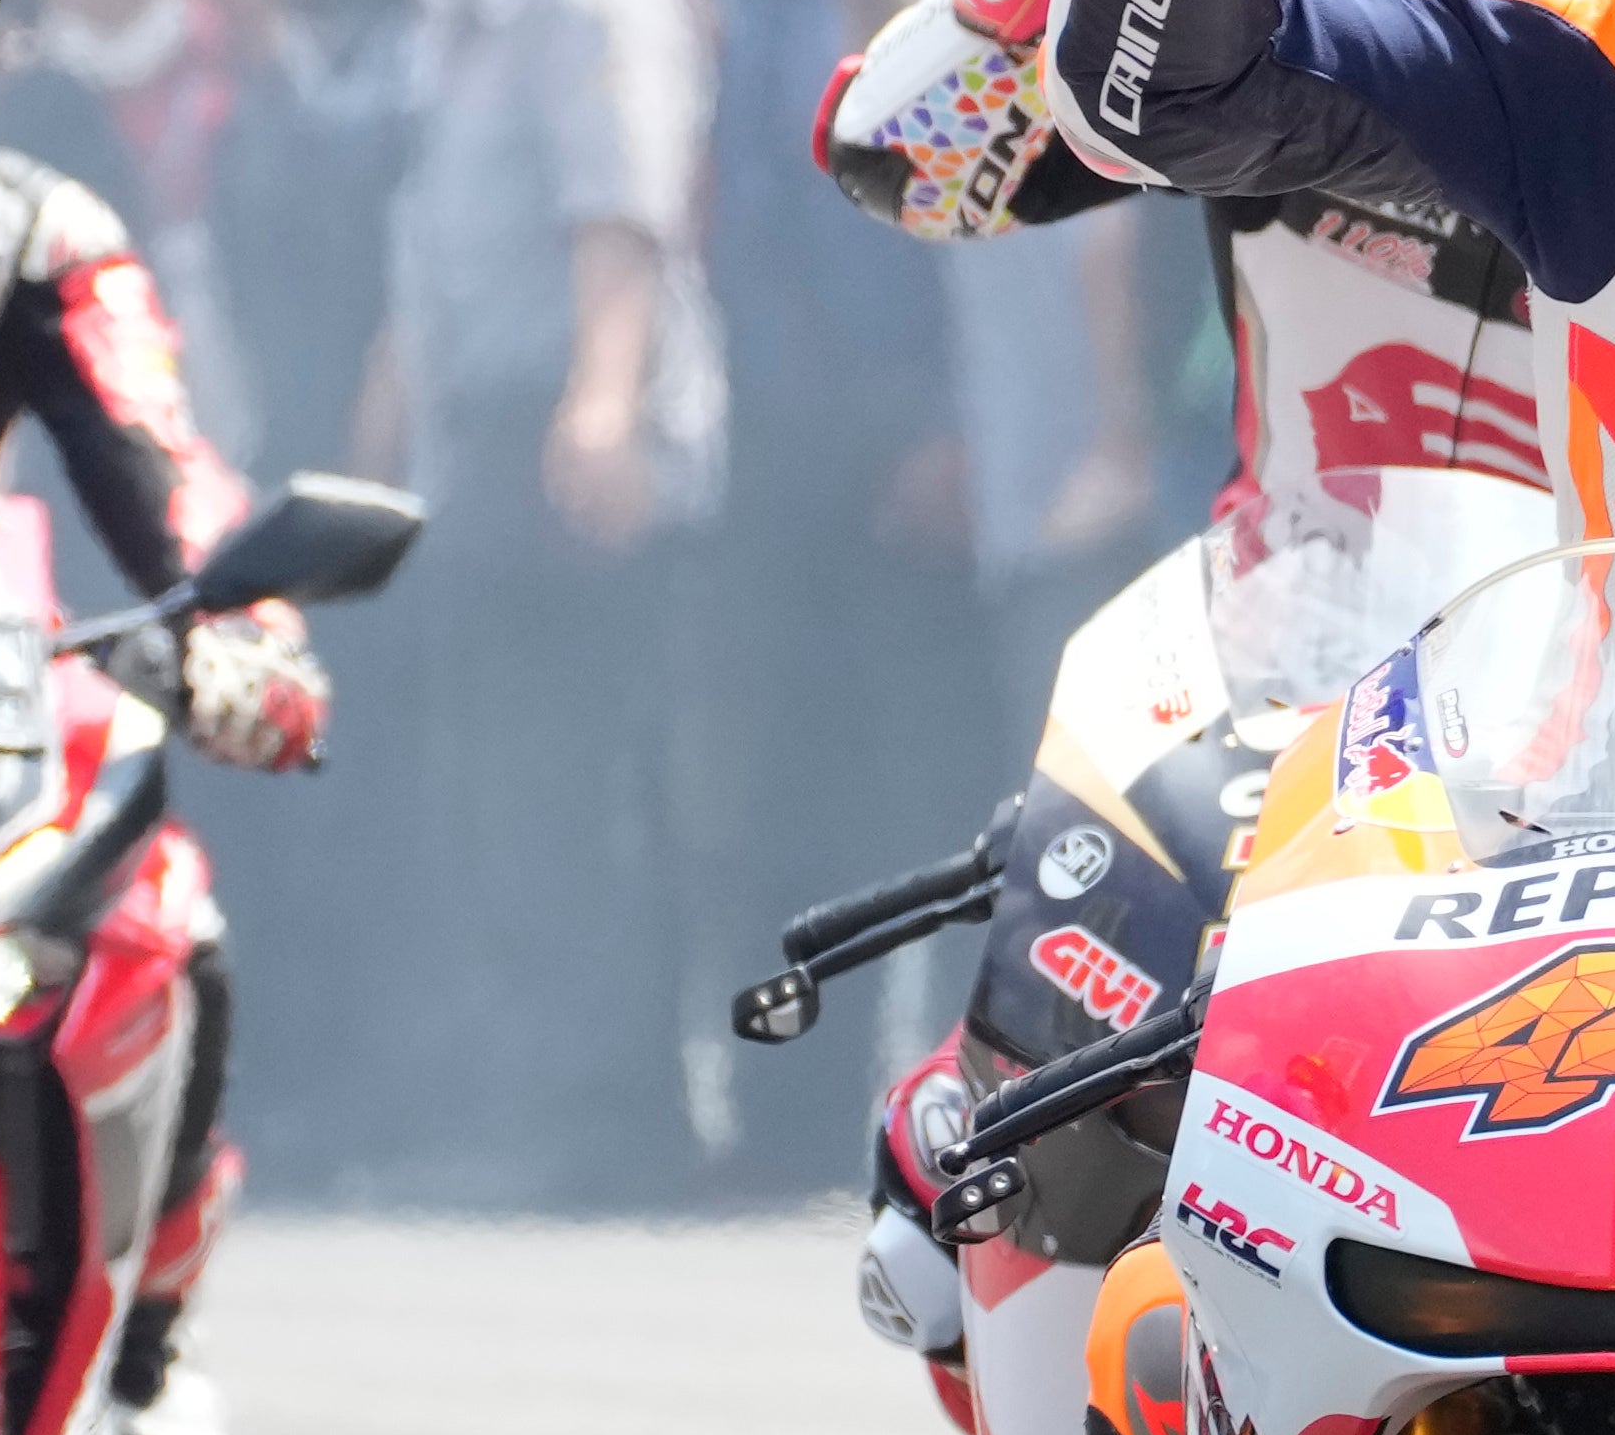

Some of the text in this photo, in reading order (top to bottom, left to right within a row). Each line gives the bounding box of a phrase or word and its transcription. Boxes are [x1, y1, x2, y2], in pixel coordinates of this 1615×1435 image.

[1035, 930, 1159, 1028] GIVI
[1204, 1099, 1403, 1230] HONDA
[1177, 1182, 1296, 1278] HRC
